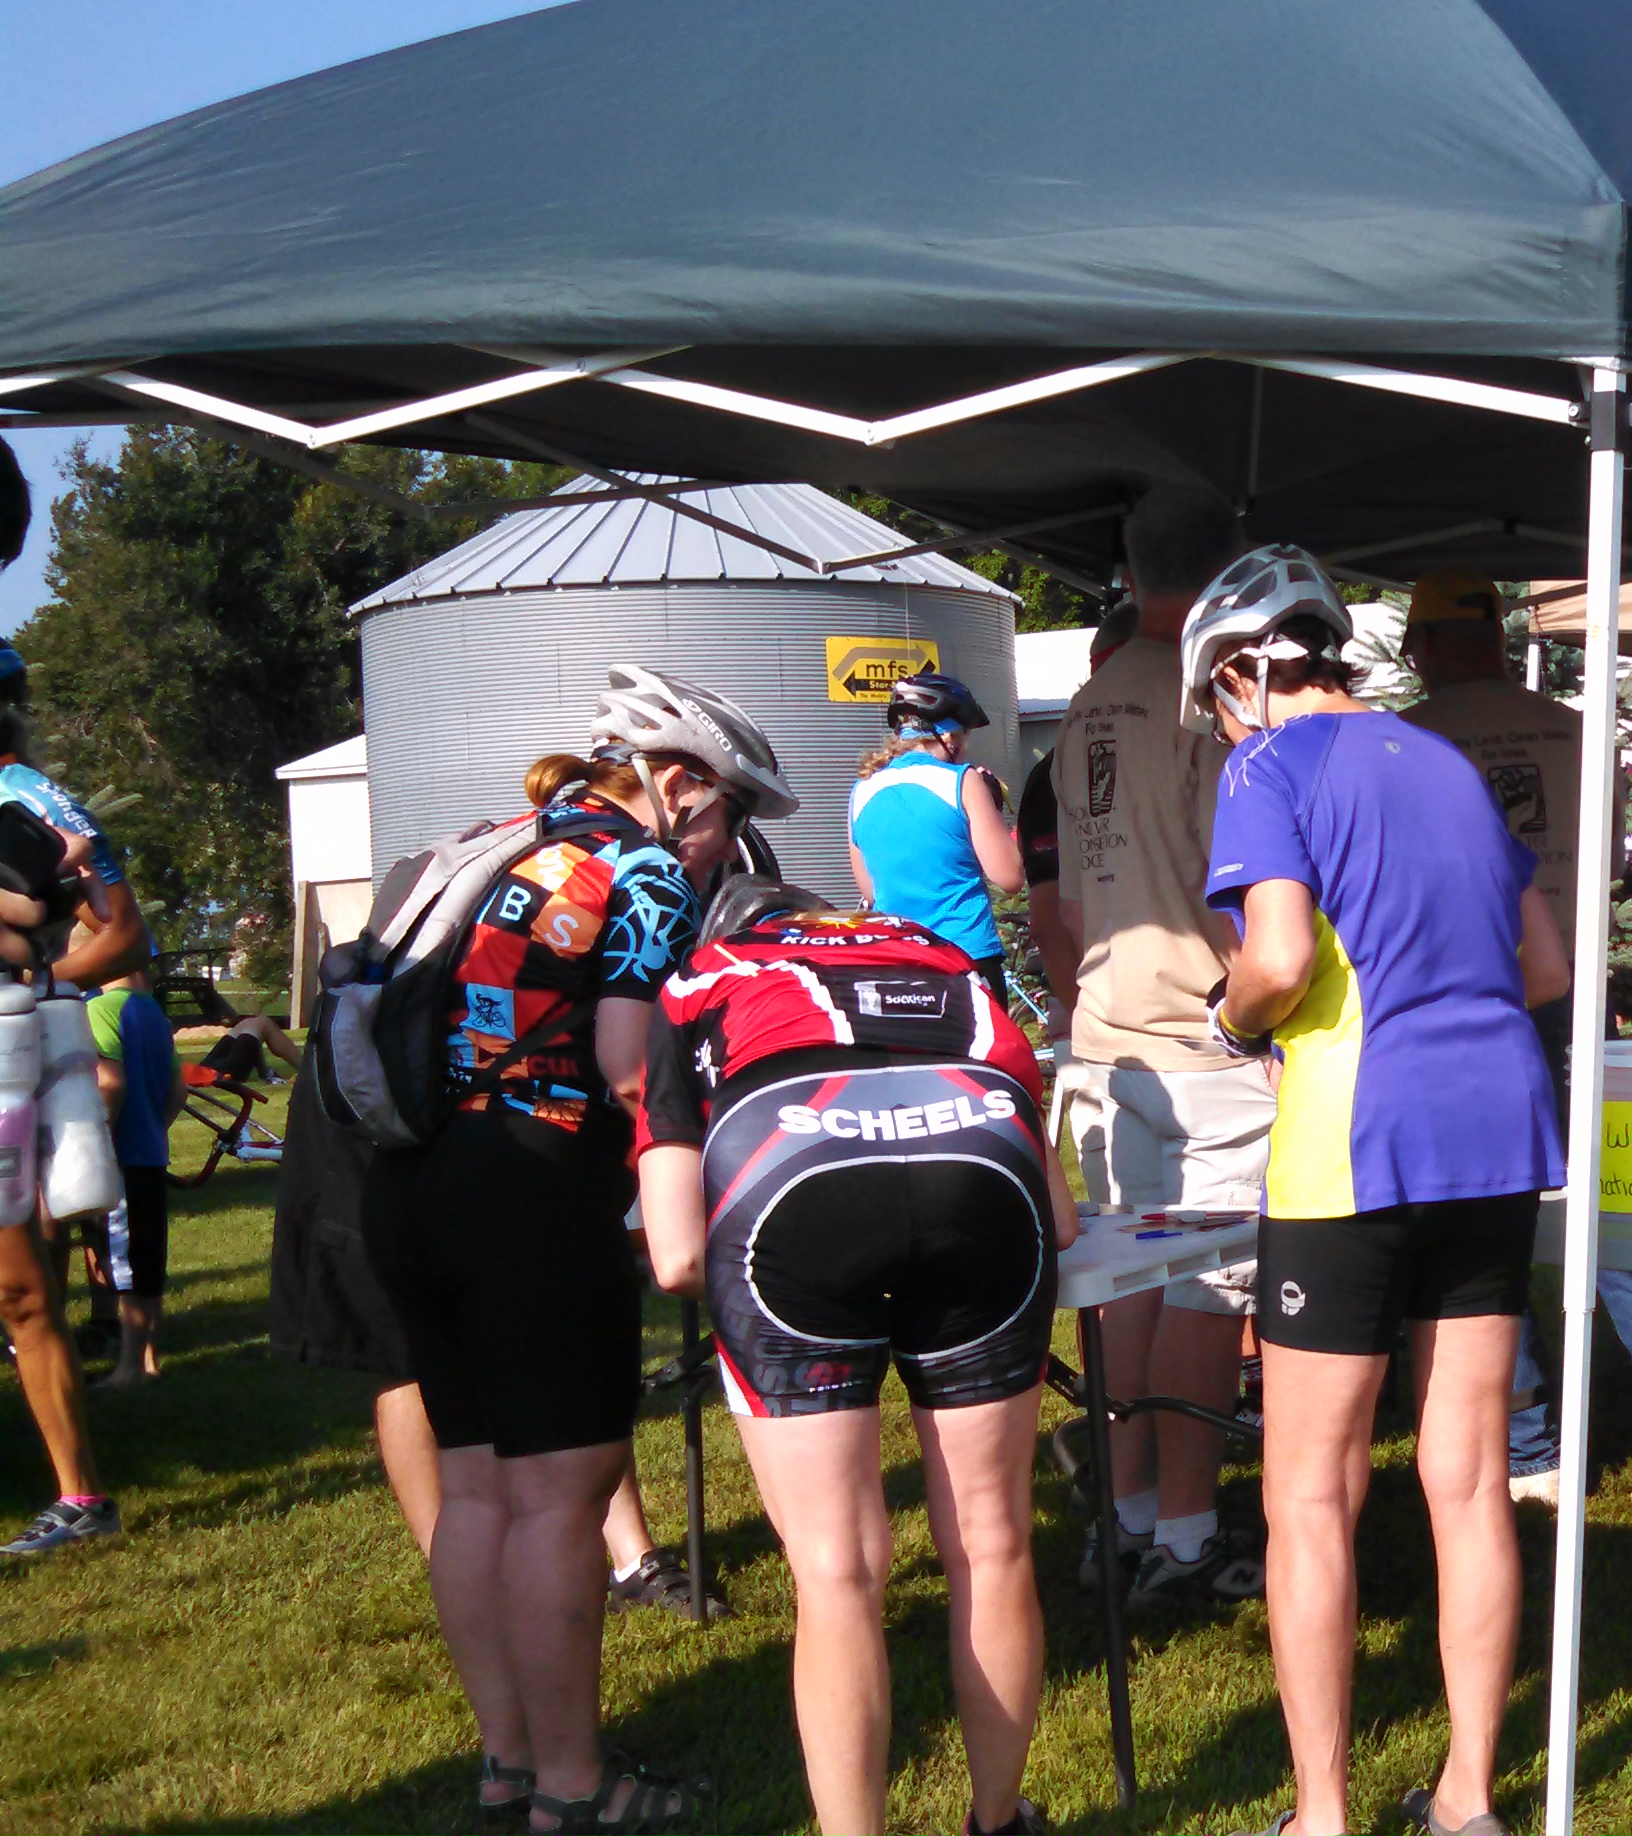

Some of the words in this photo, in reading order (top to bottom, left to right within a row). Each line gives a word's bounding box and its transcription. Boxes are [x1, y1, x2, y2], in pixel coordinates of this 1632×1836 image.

[866, 660, 908, 678] mfs
[697, 712, 732, 751] GIRO
[780, 935, 847, 945] KICK
[777, 1089, 1017, 1141] SCHEELS
